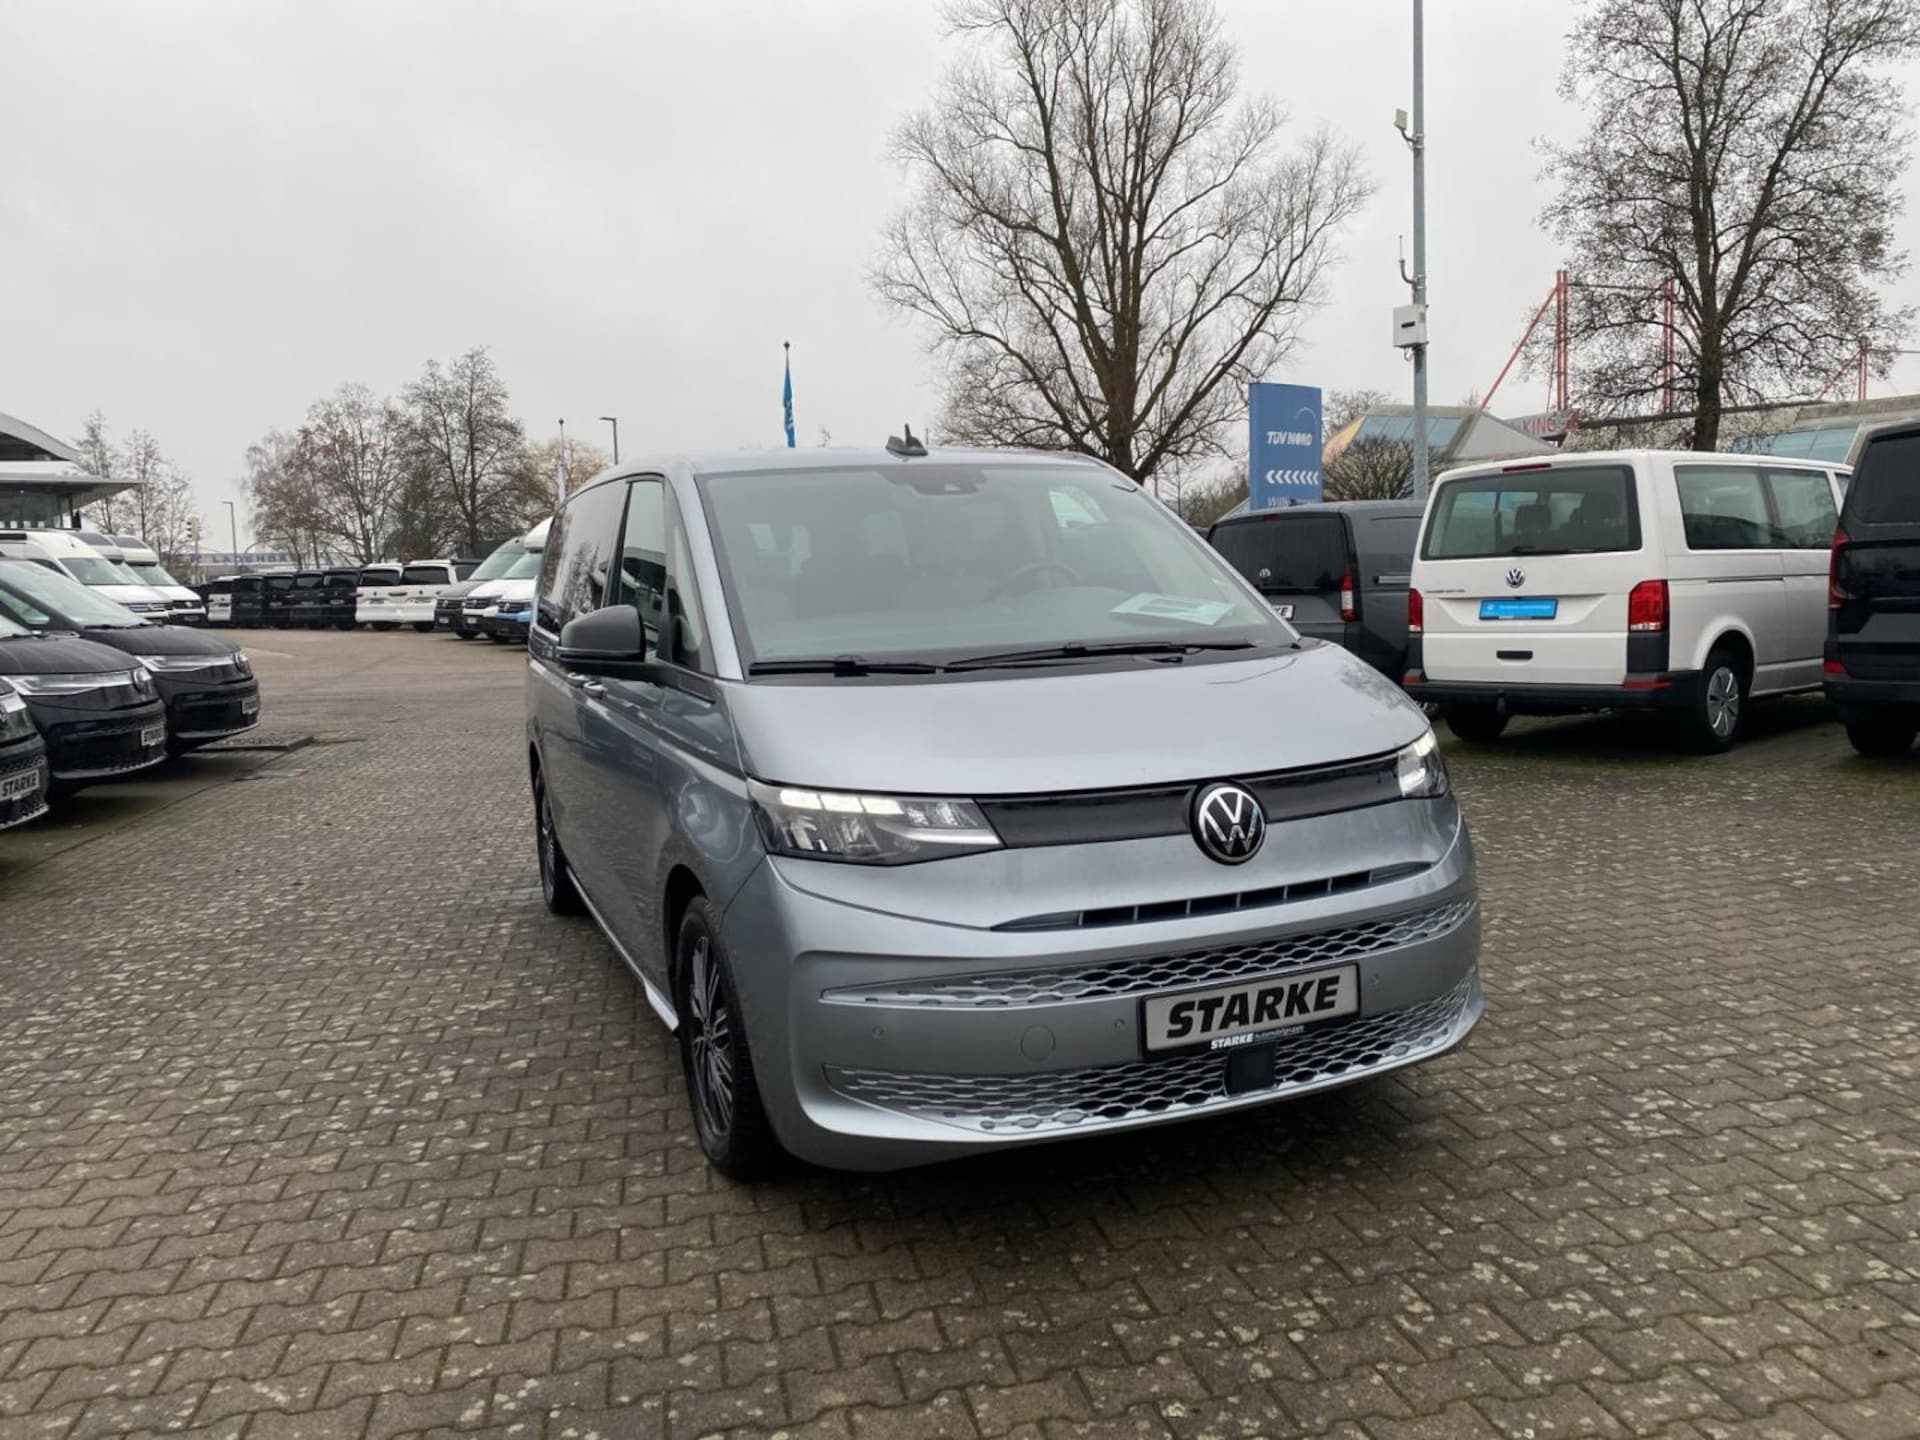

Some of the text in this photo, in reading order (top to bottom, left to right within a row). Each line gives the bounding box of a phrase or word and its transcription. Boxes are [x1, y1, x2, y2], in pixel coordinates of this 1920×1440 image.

[2, 771, 37, 797] STARKE
[1166, 975, 1341, 1040] STARKE
[1210, 1033, 1254, 1050] STARKE
